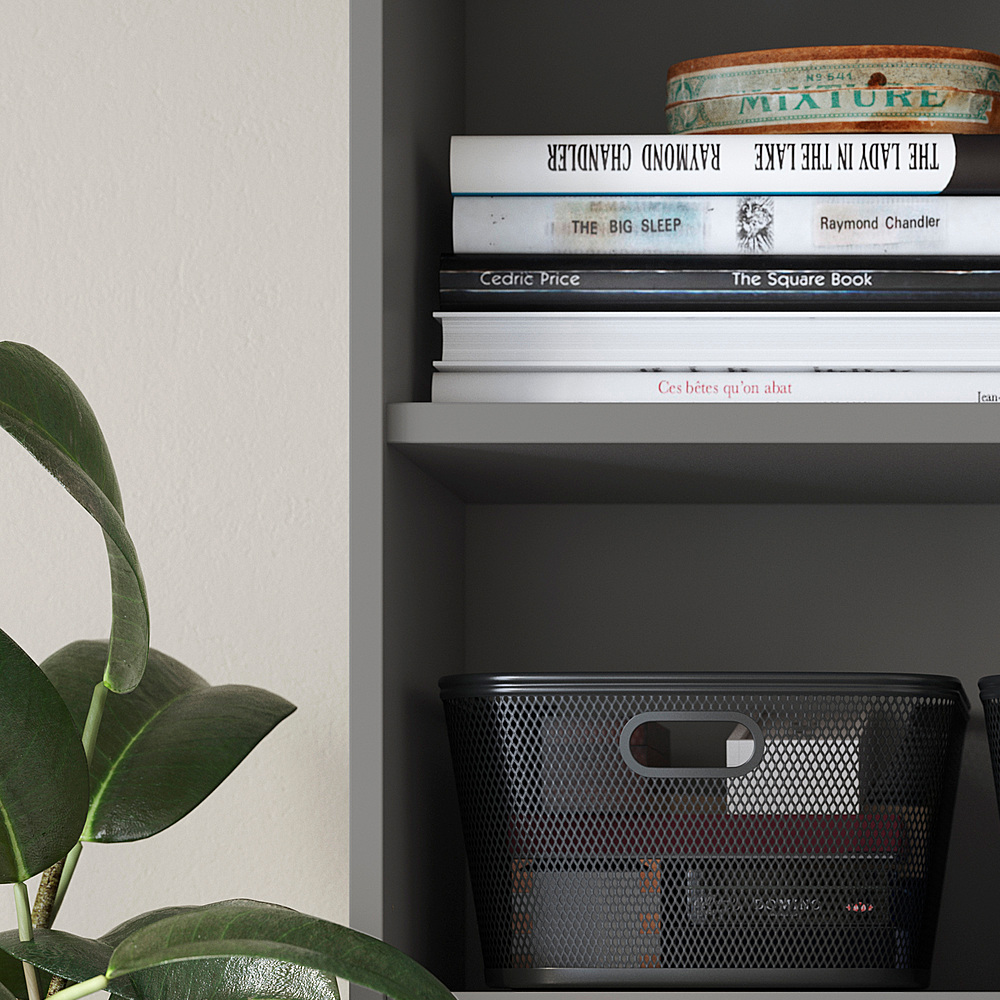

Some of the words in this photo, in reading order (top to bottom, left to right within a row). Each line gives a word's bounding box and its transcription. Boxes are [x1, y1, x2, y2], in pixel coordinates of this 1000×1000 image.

[827, 72, 852, 81] 541
[738, 83, 947, 115] MIXTURE
[547, 143, 632, 171] CHANDLER
[641, 143, 721, 171] RAYMOND
[754, 143, 796, 171] LAKE
[801, 143, 832, 170] THE
[837, 143, 854, 170] IN
[859, 143, 901, 170] LADY
[908, 143, 940, 170] THE
[571, 220, 598, 235] THE
[609, 219, 633, 234] BIG
[641, 218, 681, 233] SLEEP
[820, 216, 879, 233] Raymond
[885, 215, 941, 230] Chandler
[480, 271, 534, 286] Cedric
[540, 271, 580, 286] Price
[732, 272, 762, 286] The
[767, 272, 826, 289] Square
[831, 272, 873, 286] Book
[658, 380, 682, 394] Ces
[686, 380, 719, 394] bêtes
[764, 380, 792, 394] abat
